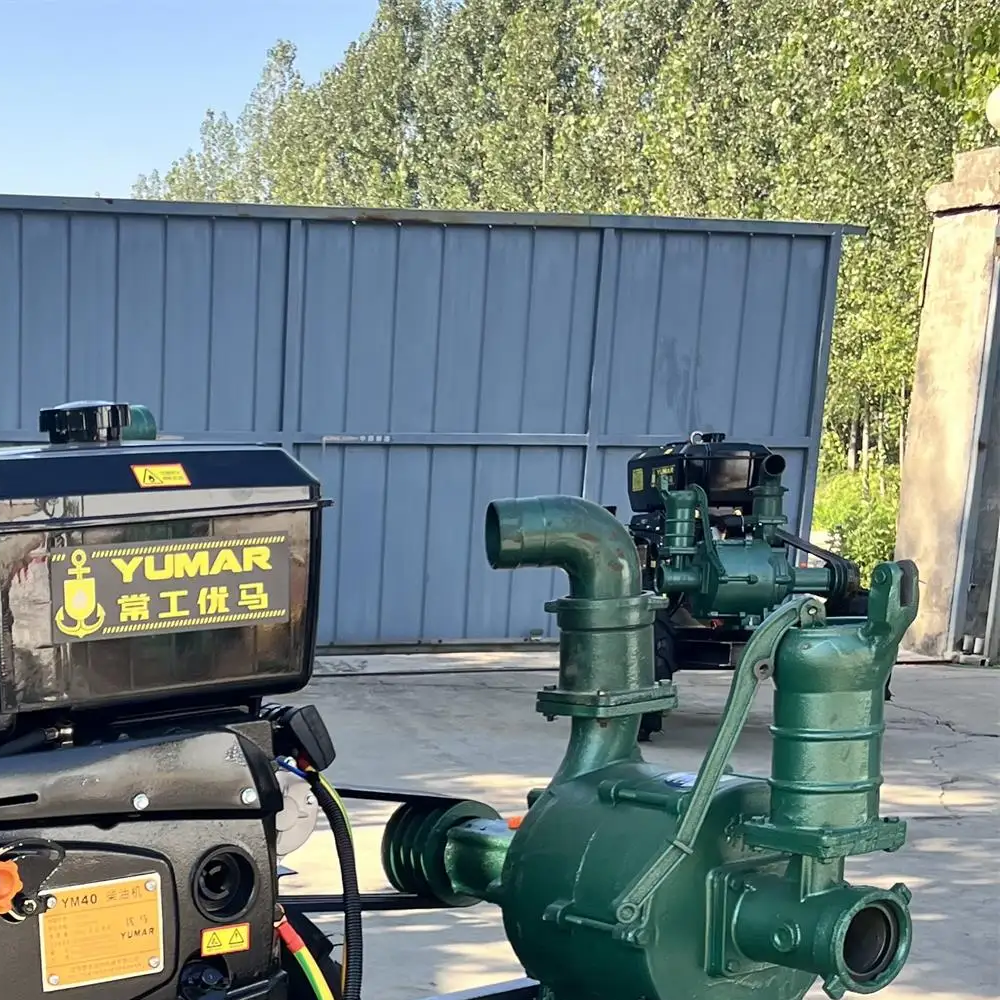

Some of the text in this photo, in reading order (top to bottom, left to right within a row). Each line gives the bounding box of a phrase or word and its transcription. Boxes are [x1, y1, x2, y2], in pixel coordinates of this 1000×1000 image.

[111, 546, 273, 583] YUMAR
[117, 582, 269, 623] 常工优马
[61, 893, 98, 909] YM40
[121, 927, 155, 939] YUMAR
